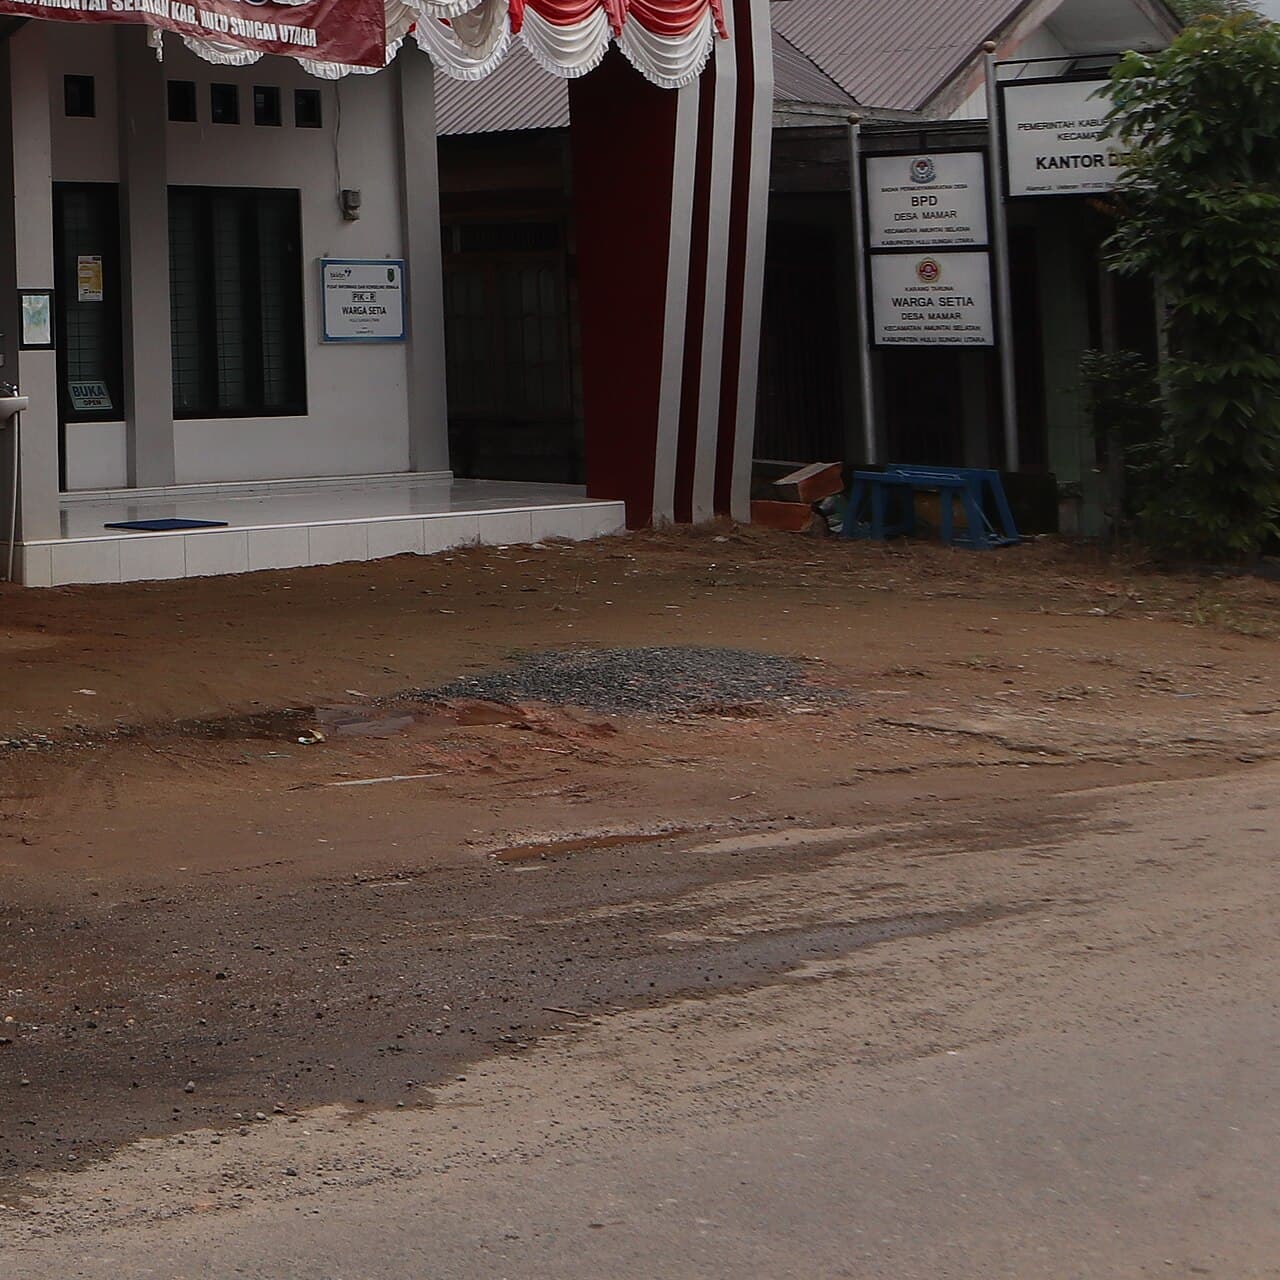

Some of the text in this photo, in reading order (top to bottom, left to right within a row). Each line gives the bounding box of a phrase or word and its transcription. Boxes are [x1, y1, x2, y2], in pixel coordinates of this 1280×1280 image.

[171, 2, 199, 25] KAB.
[231, 17, 278, 41] SUNGAI
[279, 25, 317, 47] UTARA
[1017, 121, 1075, 131] PEMERINTAH
[1036, 154, 1104, 170] KANTOR
[911, 196, 937, 206] BPD
[894, 210, 957, 221] DESA MAMAR
[891, 297, 974, 307] WARGA SETIA
[342, 306, 387, 315] WARGA SETIA
[928, 312, 962, 320] MAMAR
[72, 385, 106, 397] BUKA
